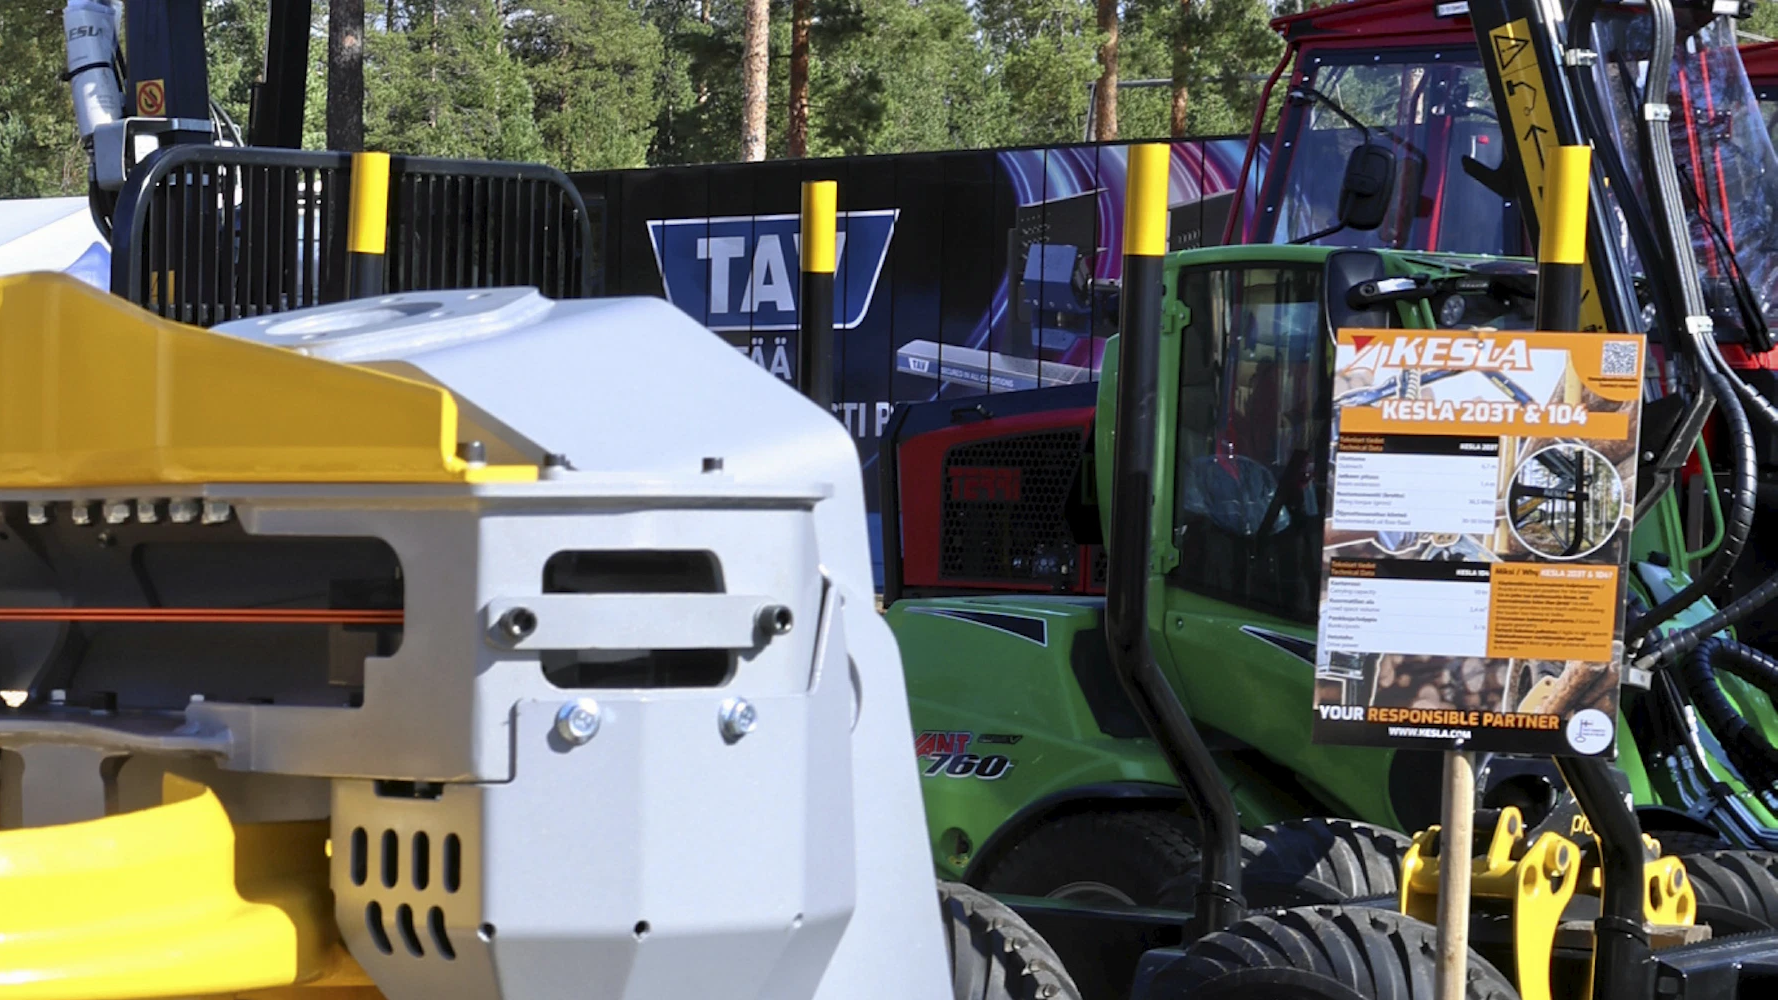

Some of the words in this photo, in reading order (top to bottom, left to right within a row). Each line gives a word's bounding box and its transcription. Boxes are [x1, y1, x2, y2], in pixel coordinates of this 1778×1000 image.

[1385, 336, 1531, 369] KESLA
[1382, 400, 1455, 422] KESLA
[1460, 402, 1519, 423] 203T
[1524, 405, 1541, 425] &
[1547, 405, 1588, 425] 104
[1319, 704, 1364, 722] YOUR
[1367, 708, 1479, 727] RESPONSIBLE
[1482, 712, 1560, 730] PARTNER
[924, 753, 1010, 780] 760
